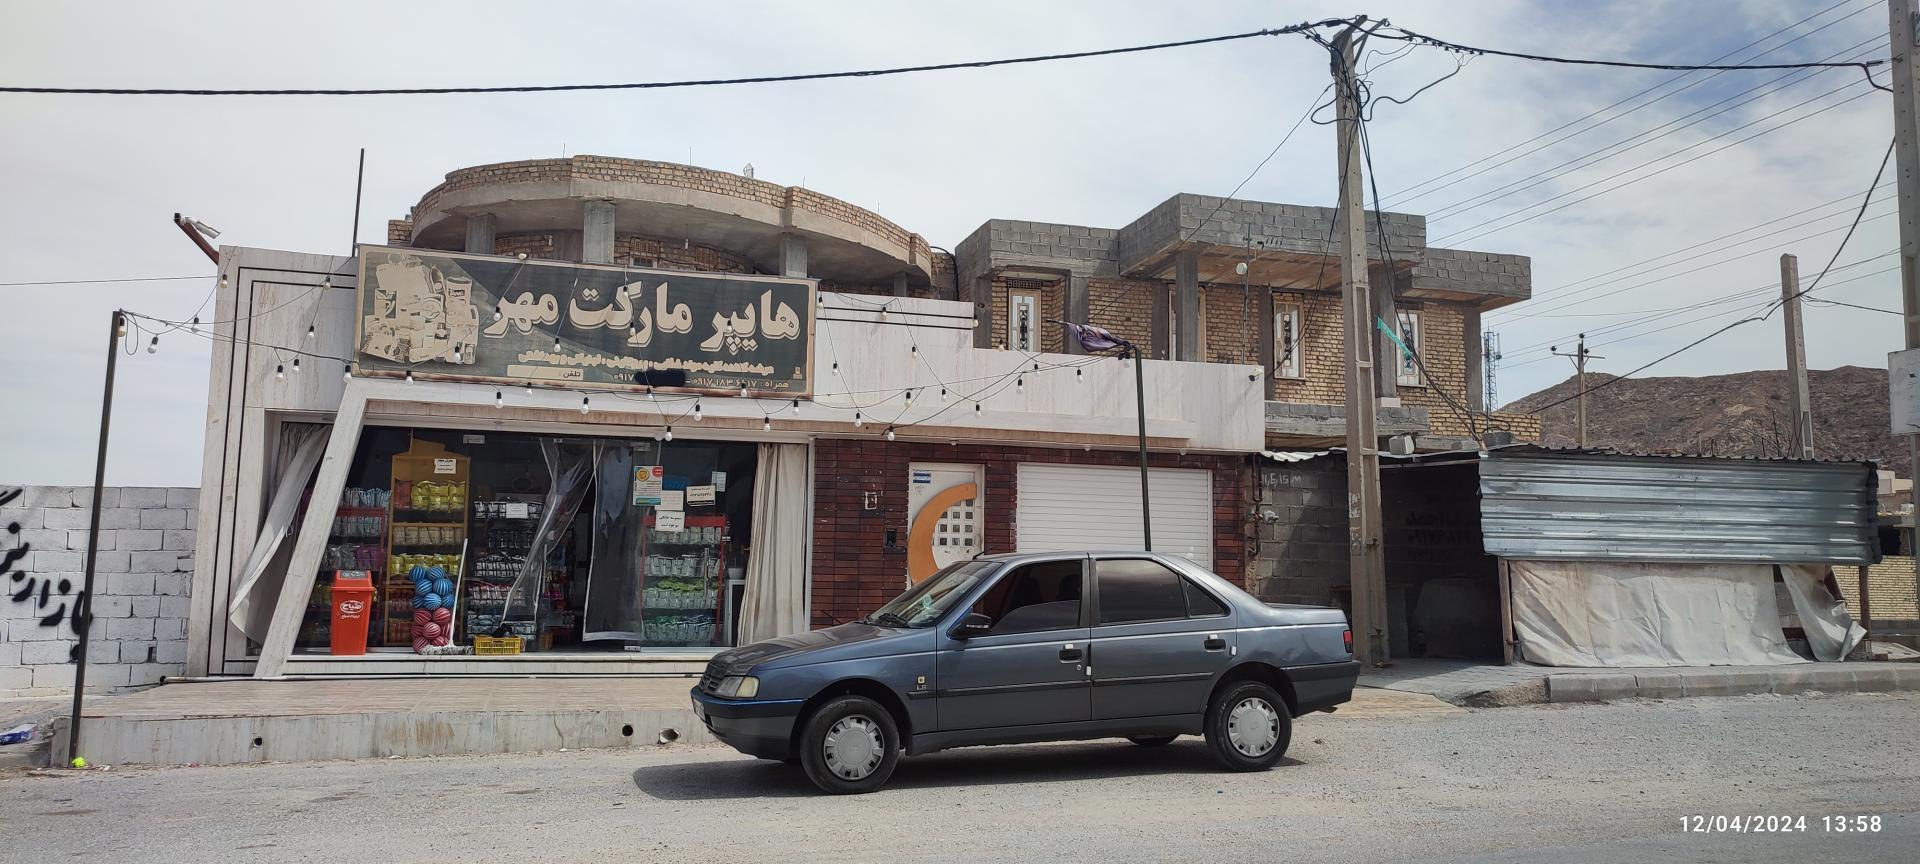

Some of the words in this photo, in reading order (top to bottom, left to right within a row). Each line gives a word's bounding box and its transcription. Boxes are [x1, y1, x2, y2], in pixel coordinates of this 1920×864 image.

[483, 291, 560, 338] مهر
[569, 281, 694, 347] مارکت
[700, 289, 801, 355] هایپر
